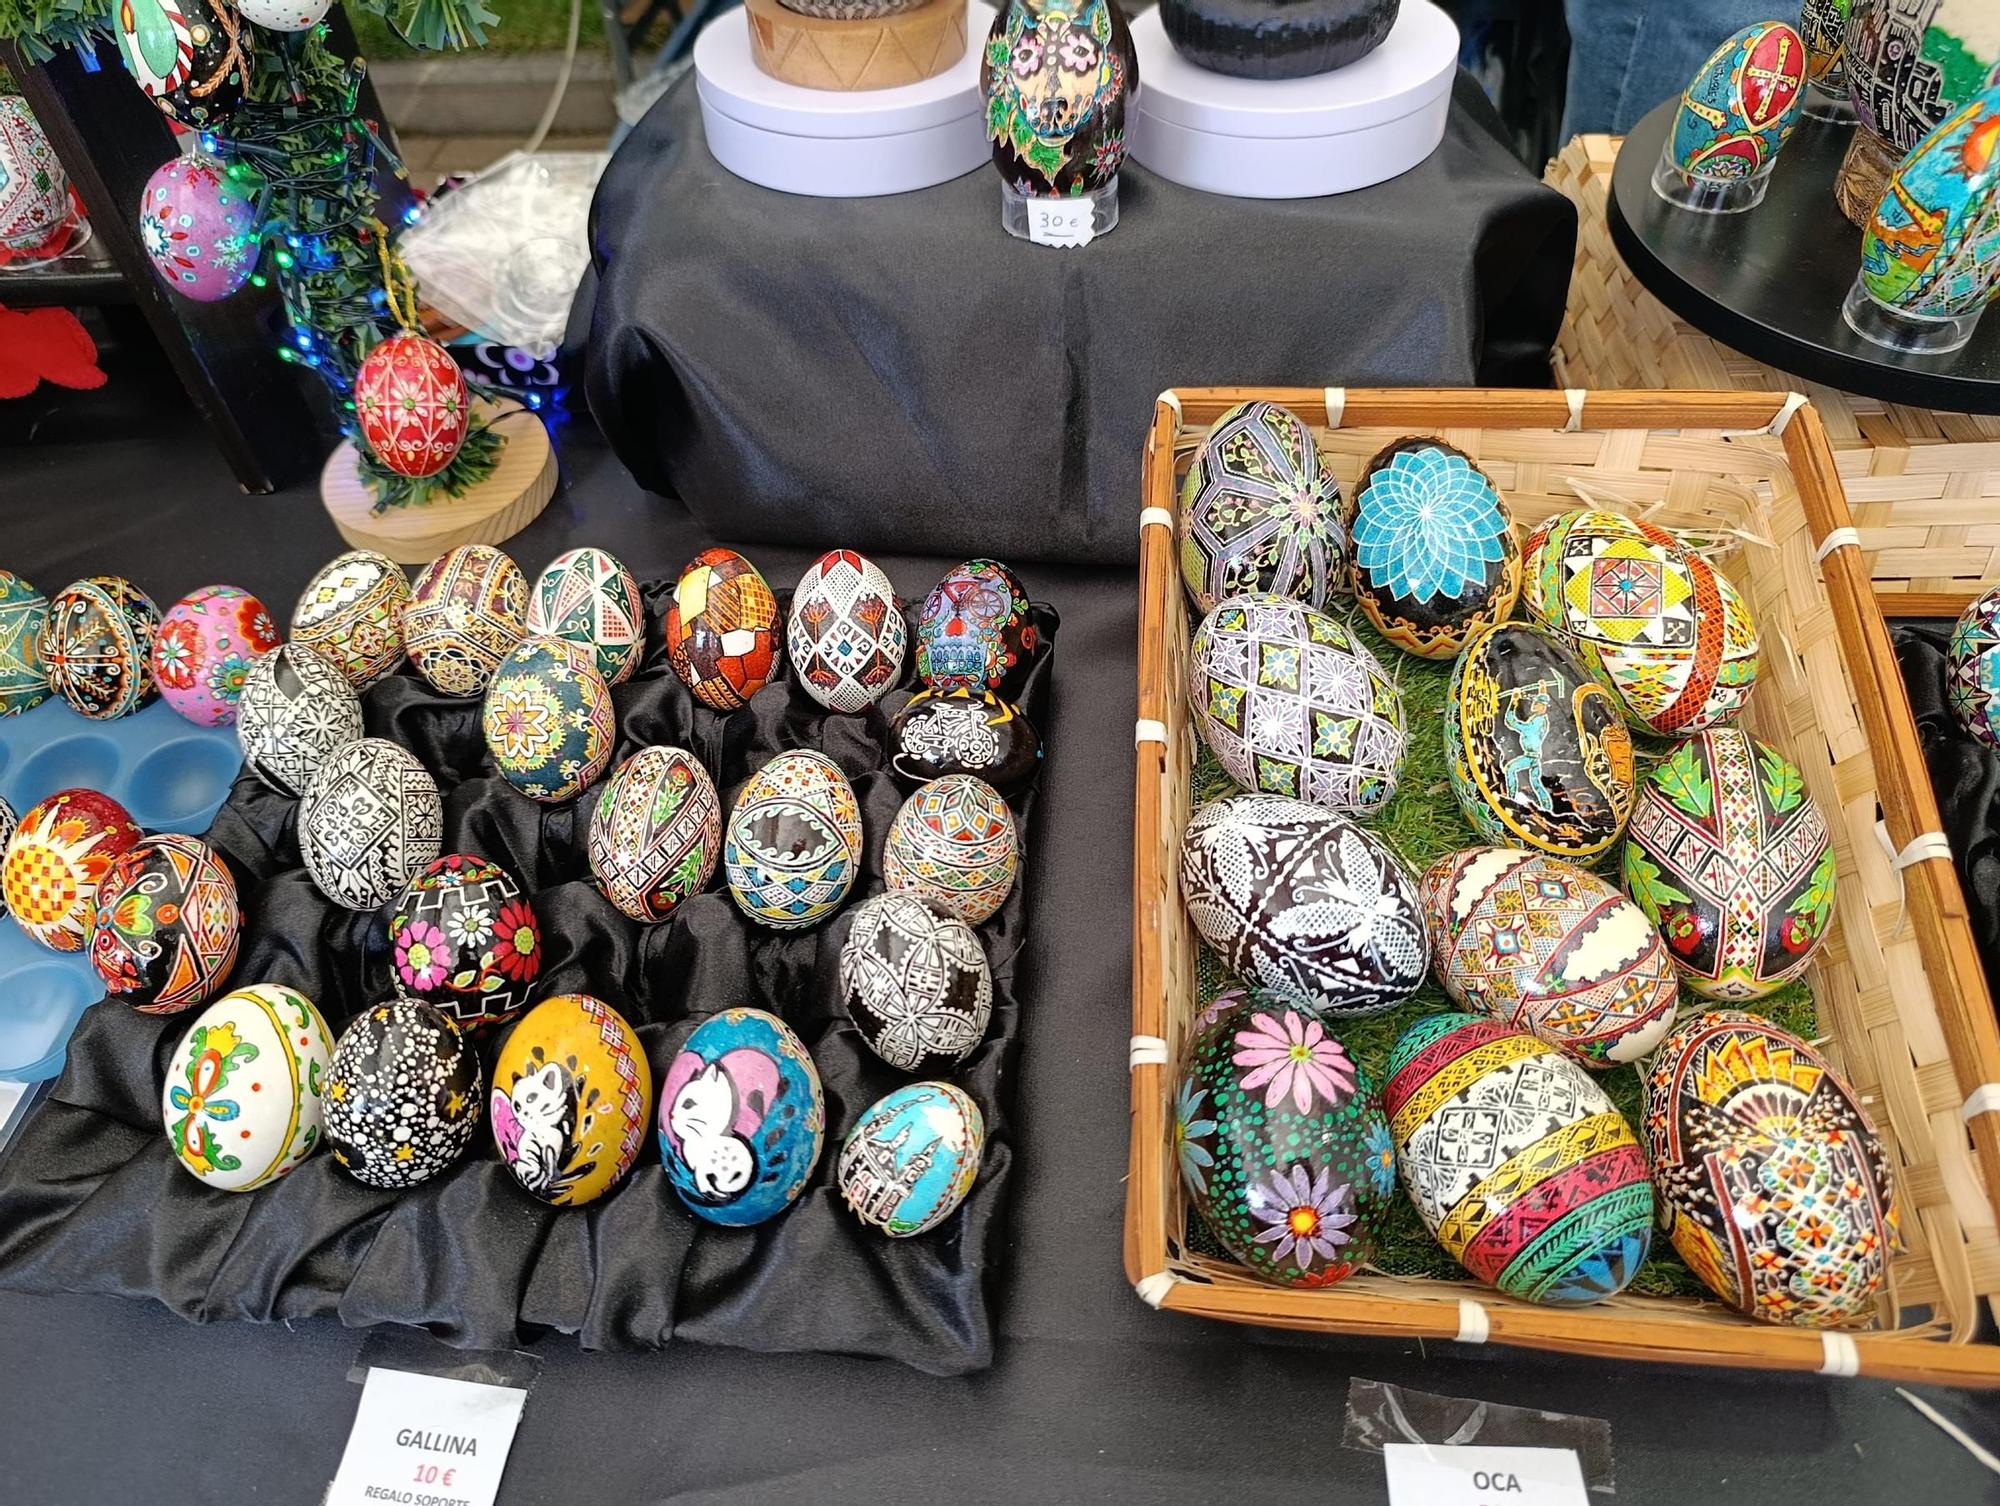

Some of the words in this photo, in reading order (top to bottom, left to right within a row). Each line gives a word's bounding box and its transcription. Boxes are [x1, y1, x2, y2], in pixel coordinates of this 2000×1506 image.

[1040, 213, 1063, 228] 30
[396, 1428, 477, 1456] GALLINA
[413, 1463, 438, 1484] 10
[442, 1468, 456, 1487] €
[1473, 1471, 1522, 1493] OCA
[364, 1485, 412, 1504] REGALO
